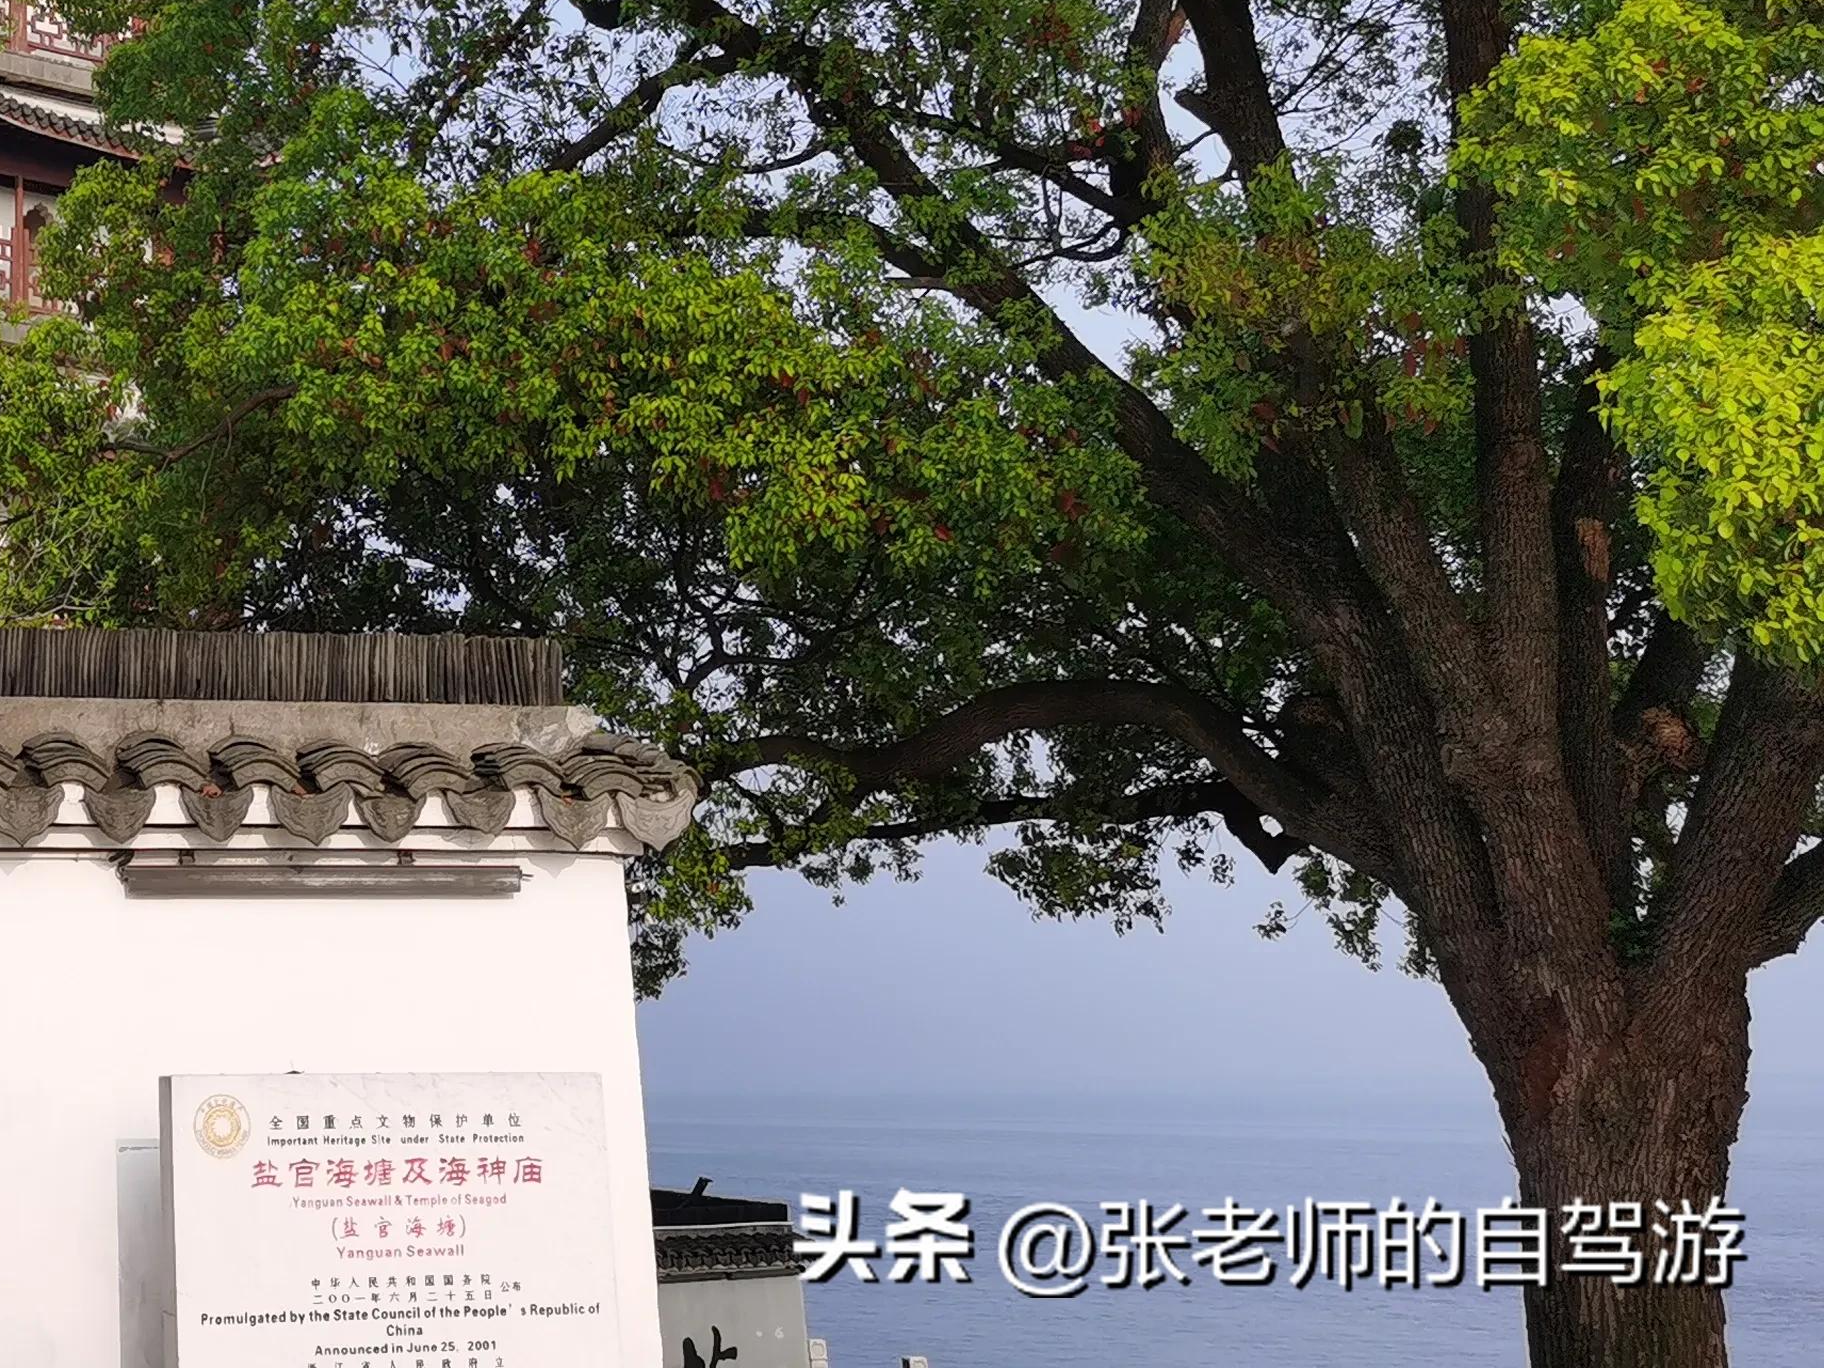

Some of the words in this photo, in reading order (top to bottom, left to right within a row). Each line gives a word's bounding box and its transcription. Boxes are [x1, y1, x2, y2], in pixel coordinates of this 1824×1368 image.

[269, 1112, 521, 1130] 全国重点文物保护单位
[268, 1136, 318, 1148] Important
[323, 1134, 366, 1148] Heritage
[372, 1134, 391, 1144] Site
[401, 1134, 429, 1144] under
[439, 1133, 465, 1144] State
[473, 1133, 524, 1144] Protection
[251, 1156, 542, 1188] 盐官海塘及海神庙
[293, 1197, 343, 1210] Yanguan
[346, 1195, 391, 1207] Seawall
[394, 1195, 403, 1206] &
[405, 1194, 448, 1208] Temple
[451, 1194, 461, 1205] of
[465, 1193, 506, 1207] Seagod
[336, 1246, 402, 1261] Yanguan
[406, 1244, 464, 1257] Seawall
[311, 1274, 491, 1291] 中华人民共和国国务院
[500, 1281, 521, 1293] 公布
[201, 1311, 286, 1326] Promulgated
[290, 1310, 305, 1324] by
[309, 1310, 330, 1322] the
[333, 1307, 368, 1322] State
[372, 1306, 420, 1320] Council
[424, 1306, 436, 1319] of
[439, 1306, 460, 1318] the
[521, 1307, 527, 1316] s
[530, 1303, 586, 1318] Republic
[588, 1302, 600, 1314] of
[386, 1324, 423, 1337] China
[315, 1343, 388, 1356] Announced
[391, 1343, 403, 1354] in
[406, 1342, 437, 1353] June
[467, 1340, 496, 1351] 2001
